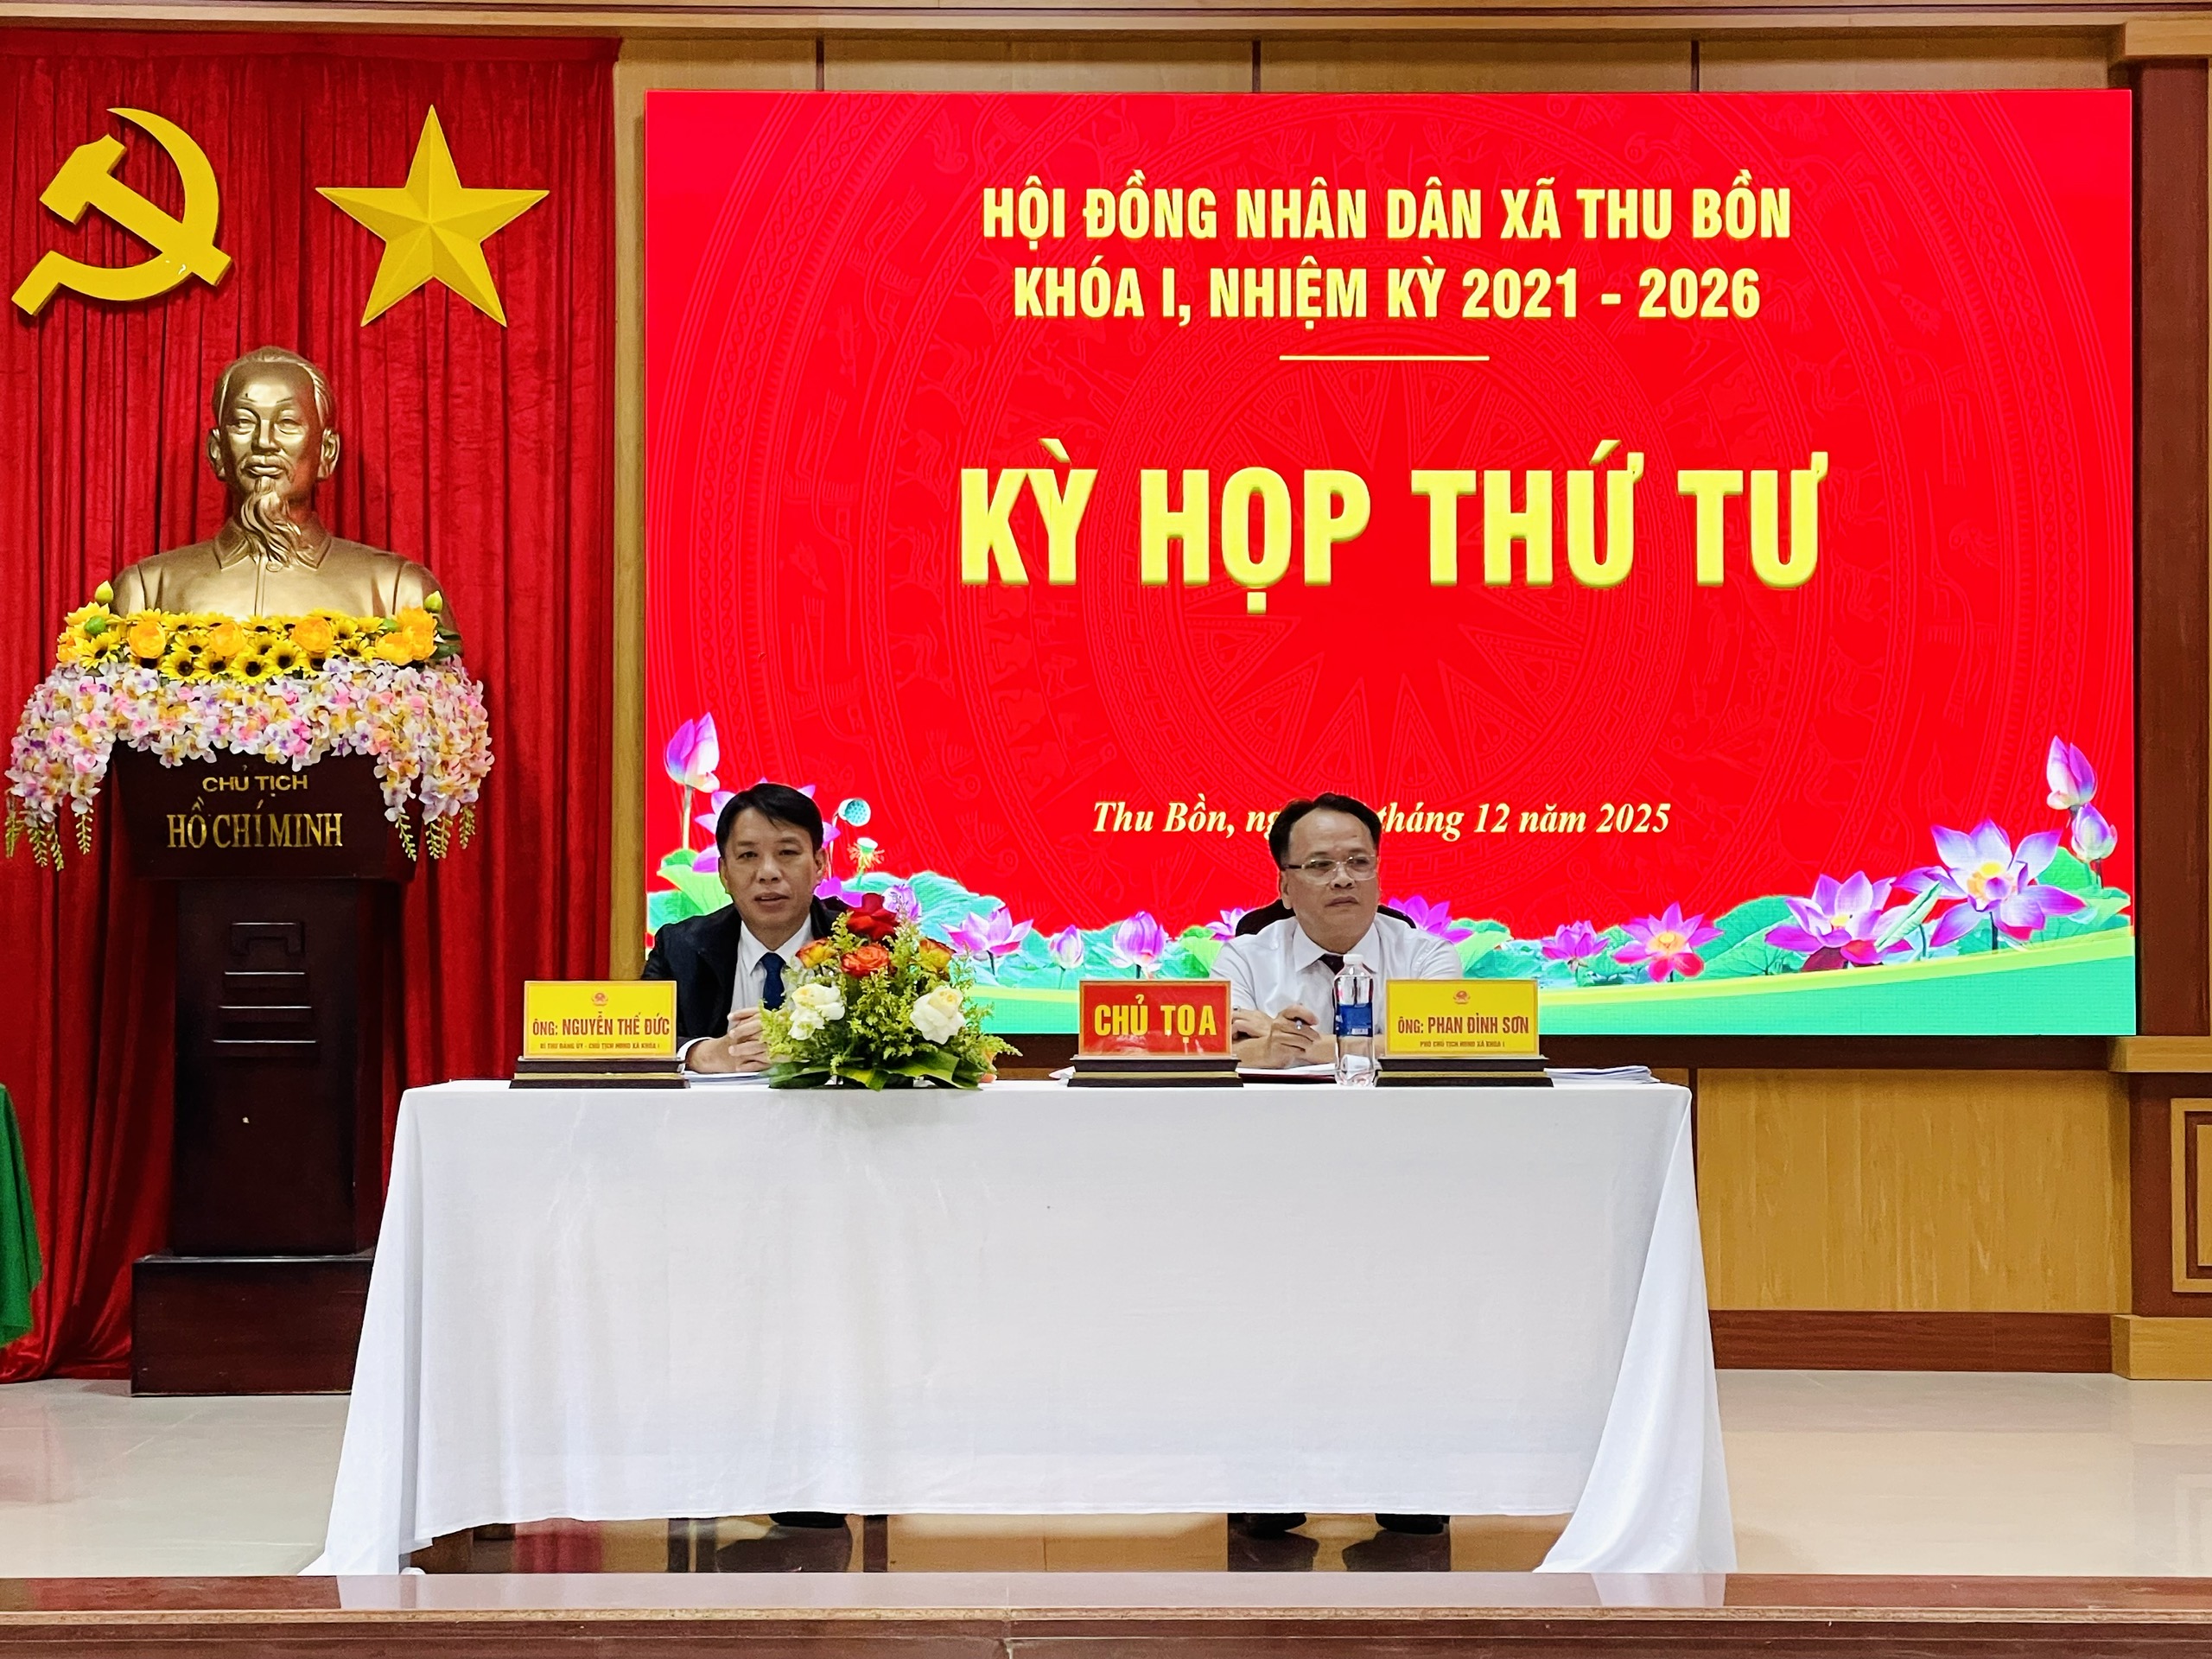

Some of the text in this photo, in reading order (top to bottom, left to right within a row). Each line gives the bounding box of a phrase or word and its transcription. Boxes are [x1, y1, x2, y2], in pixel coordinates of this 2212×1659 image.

[982, 168, 1791, 251] HỘI ĐỒNG NHÂN DÂN XÃ THU BỒN
[1014, 254, 1761, 330] KHÓA I, NHIỆM KỲ 2021 - 2026
[959, 437, 1829, 614] KỲ HỌP THỨ TƯ
[202, 764, 308, 797] CHỦ TỊCH
[166, 796, 343, 849] HỒ CHÍ MINH
[1093, 801, 1154, 832] Thu
[1162, 792, 1236, 839] Bồn,
[1377, 801, 1465, 842] tháng
[1473, 803, 1510, 833] 12
[1518, 803, 1586, 833] năm
[1595, 803, 1672, 833] 2025
[532, 1011, 671, 1036] ÔNG: NGUYỄN THẾ ĐỨC
[1094, 994, 1217, 1044] CHỦ TỌA
[1397, 1012, 1529, 1034] ÔNG: PHAN ĐÌNH SƠN
